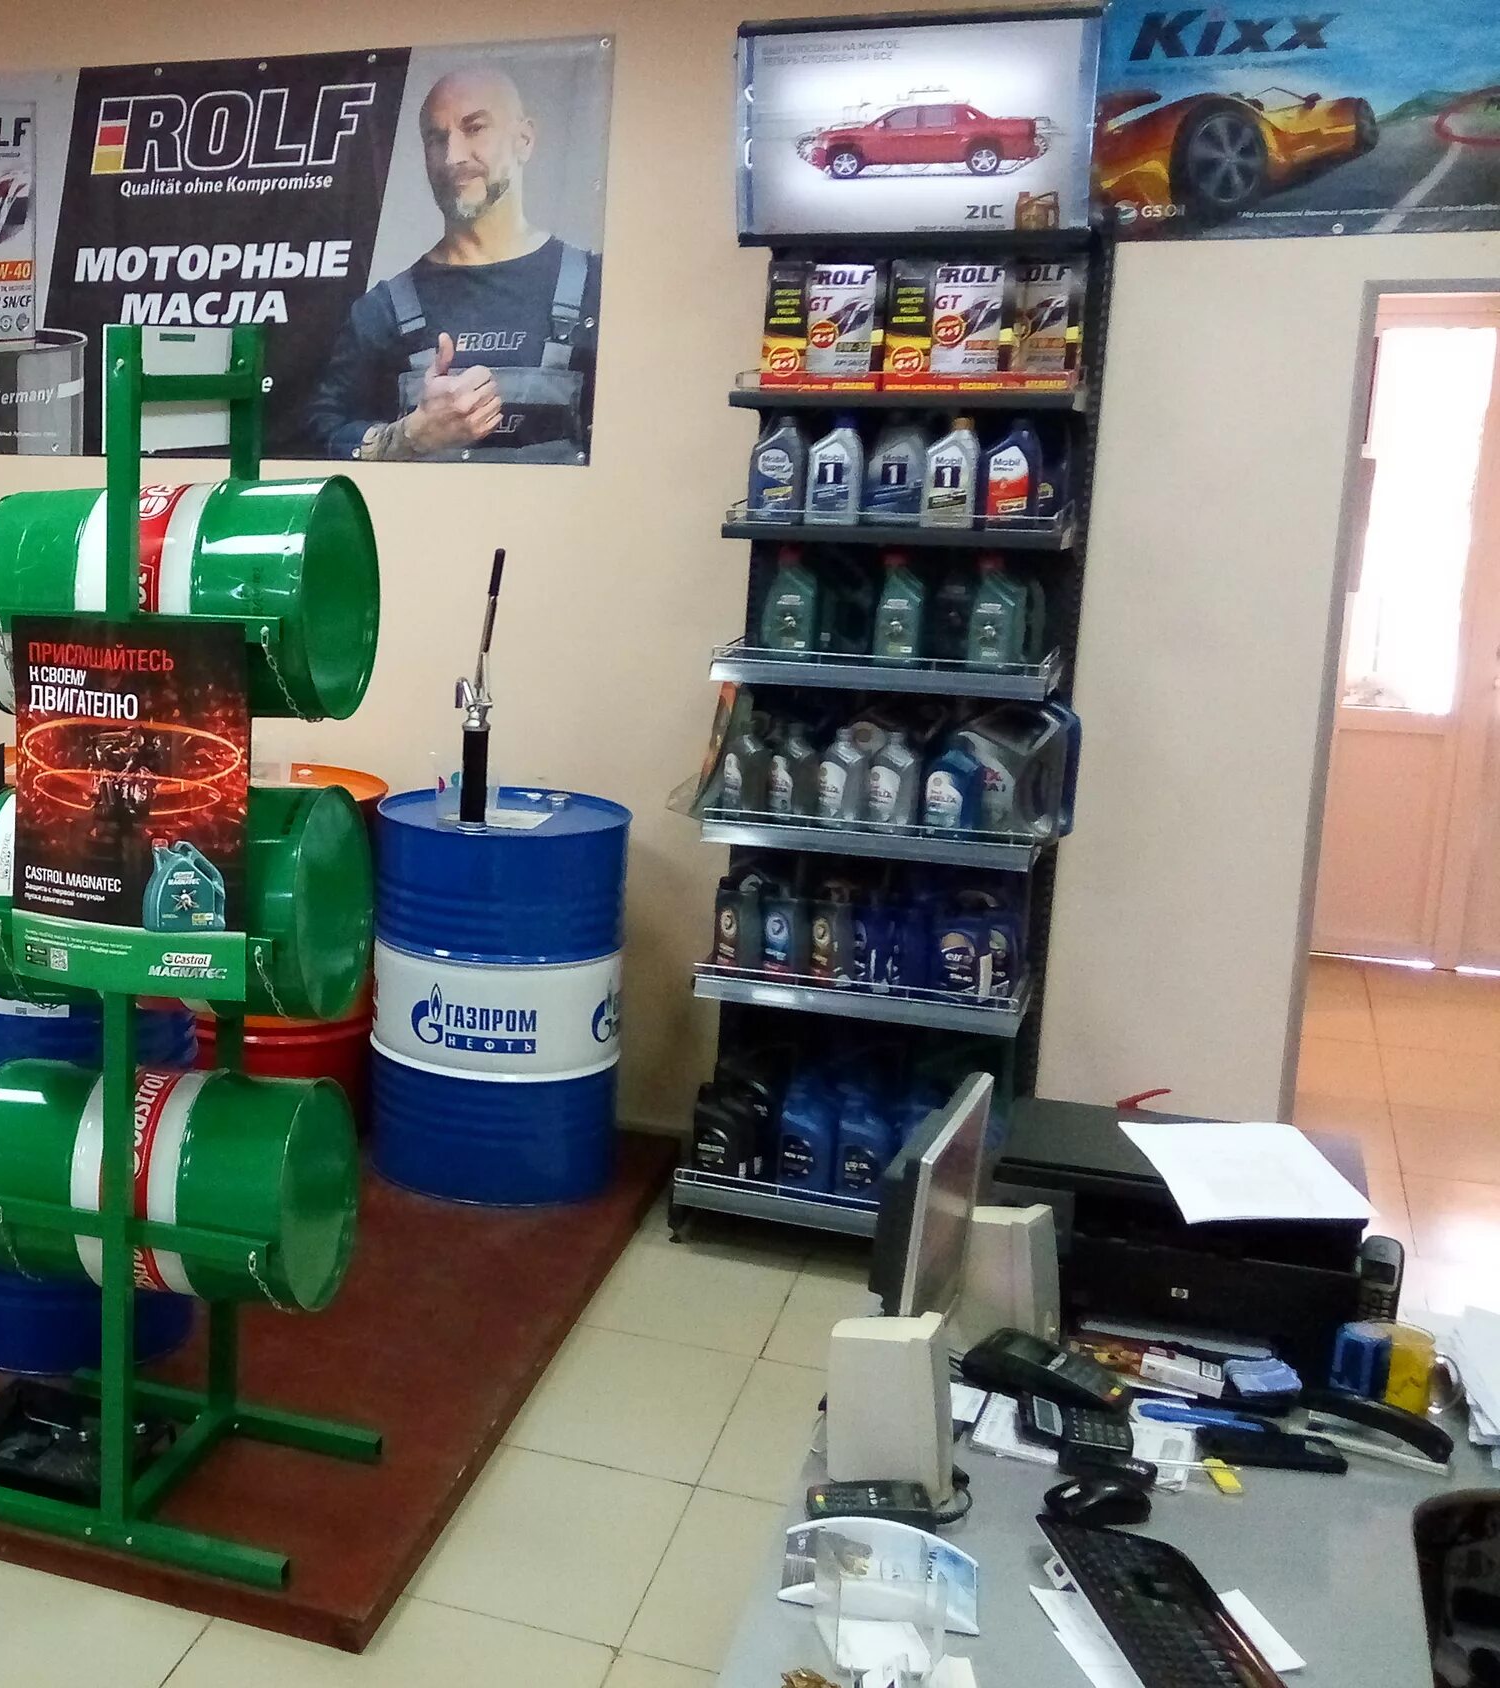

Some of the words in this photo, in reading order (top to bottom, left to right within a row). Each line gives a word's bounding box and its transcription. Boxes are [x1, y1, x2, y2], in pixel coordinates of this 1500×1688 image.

[1128, 9, 1342, 61] Kixx
[118, 82, 376, 174] ROLF
[120, 177, 181, 198] Qualität
[184, 175, 223, 194] ohne
[226, 172, 333, 195] Kompromisse
[965, 204, 1004, 220] ZIC
[1141, 204, 1163, 219] GS
[74, 240, 353, 284] МОТОРНЫЕ
[818, 268, 876, 286] ROLF
[945, 266, 1006, 284] ROLF
[3, 295, 32, 309] SN/CF
[120, 290, 289, 325] МАСЛА
[810, 296, 834, 312] GT
[935, 294, 963, 310] GT
[463, 331, 527, 351] ROLF
[935, 456, 964, 465] Mobil
[993, 457, 1021, 466] Mobil
[824, 463, 835, 484] 1
[888, 464, 899, 485] 1
[941, 467, 952, 487] 1
[28, 642, 175, 672] ПРИСЛУШАЙТЕСЬ
[41, 666, 87, 686] СВОЕМУ
[29, 684, 139, 720] ДВИГАТЕЛЮ
[25, 864, 65, 885] CASTROL
[65, 872, 122, 893] MAGNATEC
[174, 954, 208, 966] Castrol
[148, 965, 228, 979] MAGNATEC
[445, 1003, 537, 1033] ГАЗПРОМ
[447, 1036, 534, 1052] НЕФТЬ
